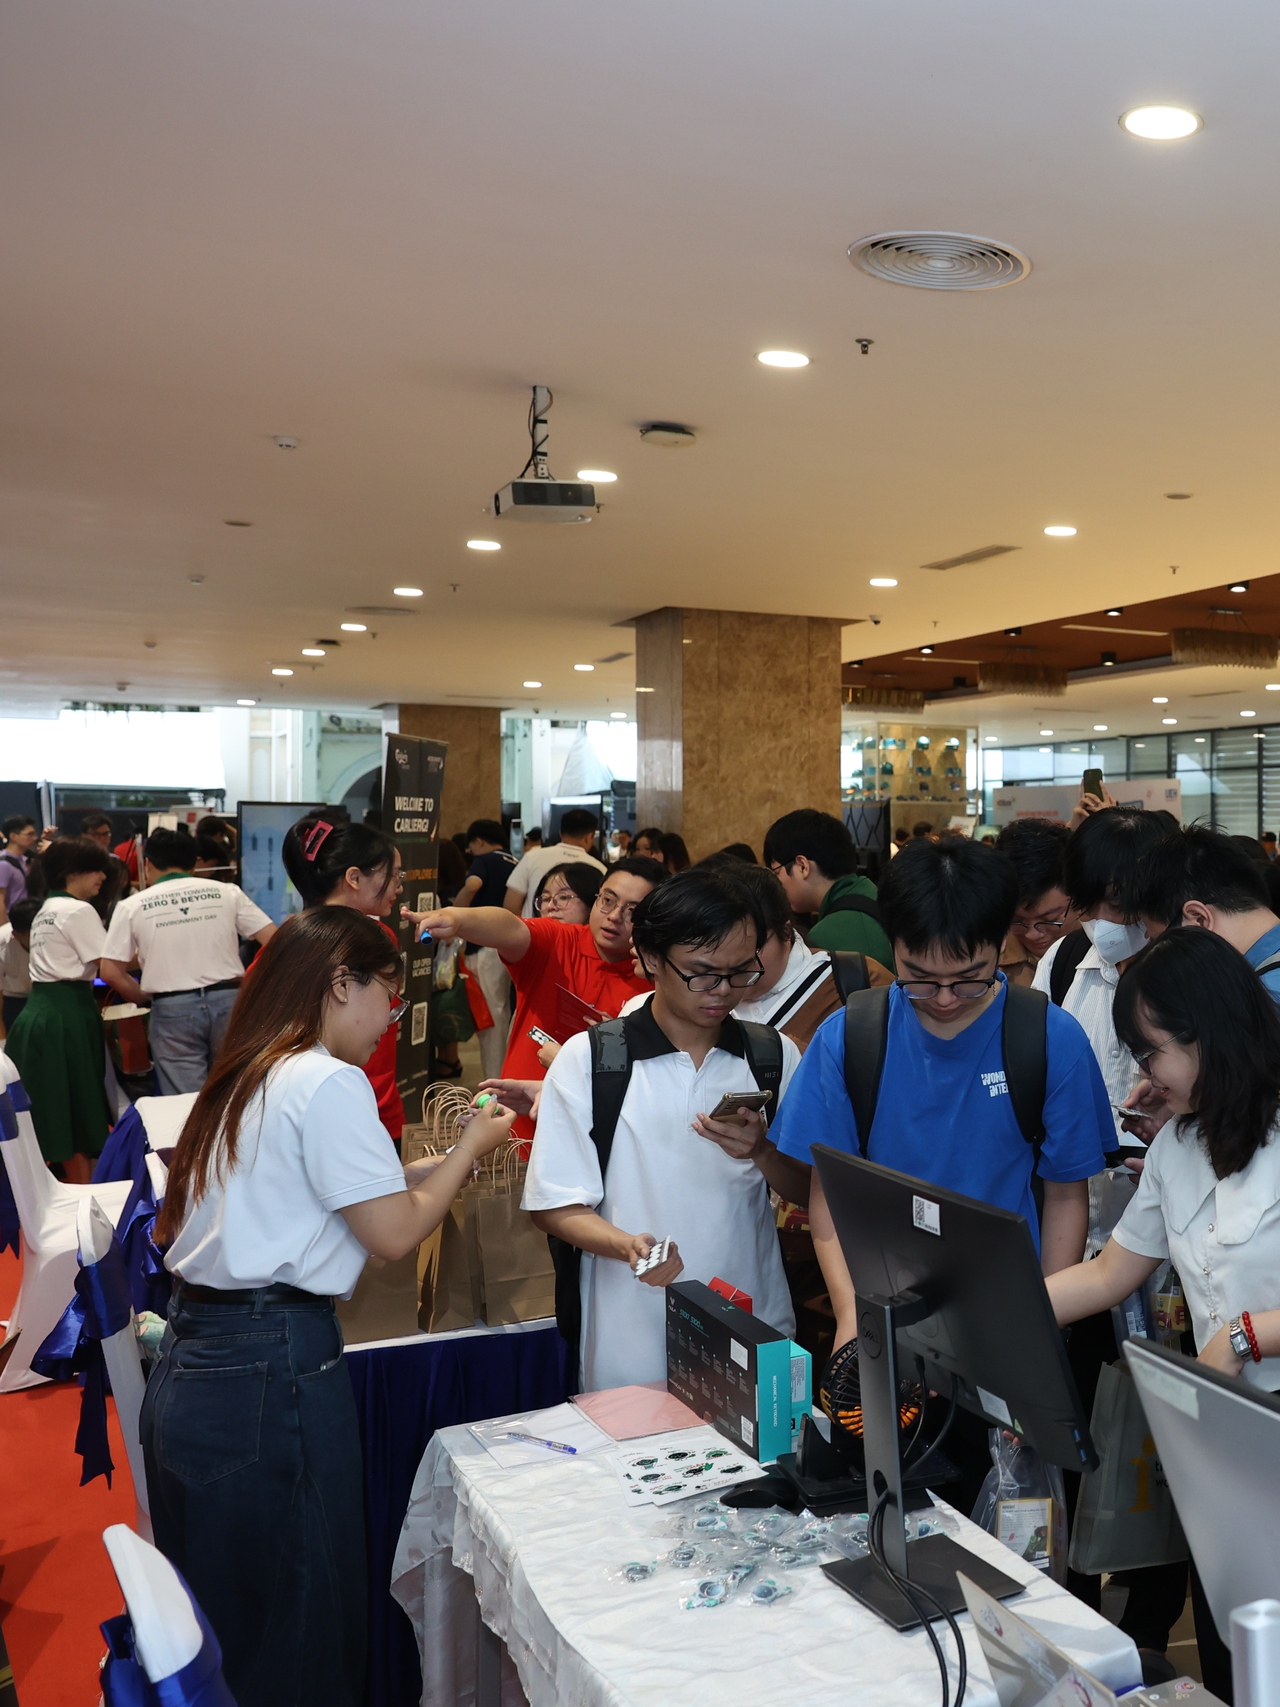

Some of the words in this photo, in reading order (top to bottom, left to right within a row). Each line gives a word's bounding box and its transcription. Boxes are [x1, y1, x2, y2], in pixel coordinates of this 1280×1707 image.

[143, 899, 168, 911] ZERO
[181, 893, 222, 904] BEYOND
[981, 1070, 1006, 1086] WOND
